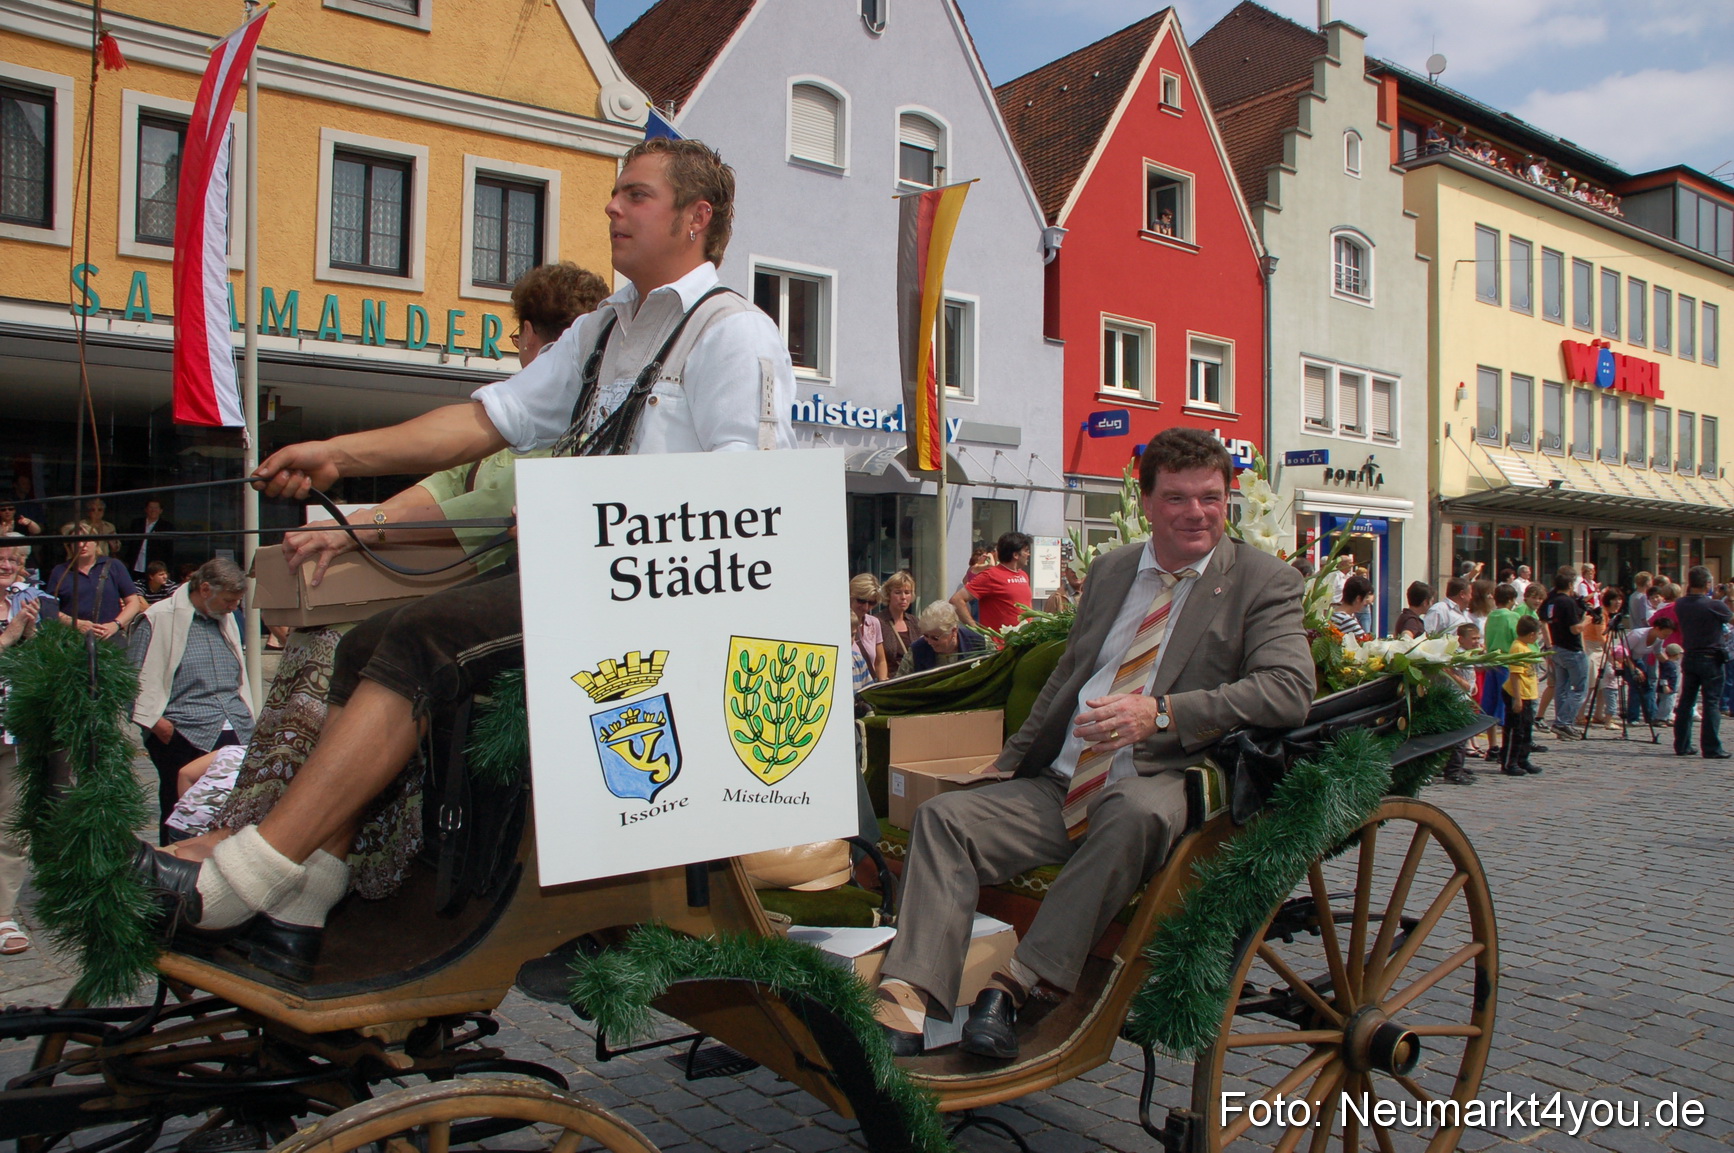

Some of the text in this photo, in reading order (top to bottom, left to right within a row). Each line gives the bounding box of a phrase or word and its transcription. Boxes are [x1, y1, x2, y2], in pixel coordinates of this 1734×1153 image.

[71, 262, 504, 360] SAMANDER
[1561, 338, 1665, 400] WÖHRL
[1287, 450, 1323, 465] BONITA
[1325, 455, 1384, 487] BONITA
[1068, 479, 1077, 488] 45
[592, 501, 782, 548] Partner
[1352, 519, 1374, 532] BONITA
[610, 548, 772, 602] Städte
[619, 796, 690, 827] Issoire
[722, 788, 811, 806] Mistelbach
